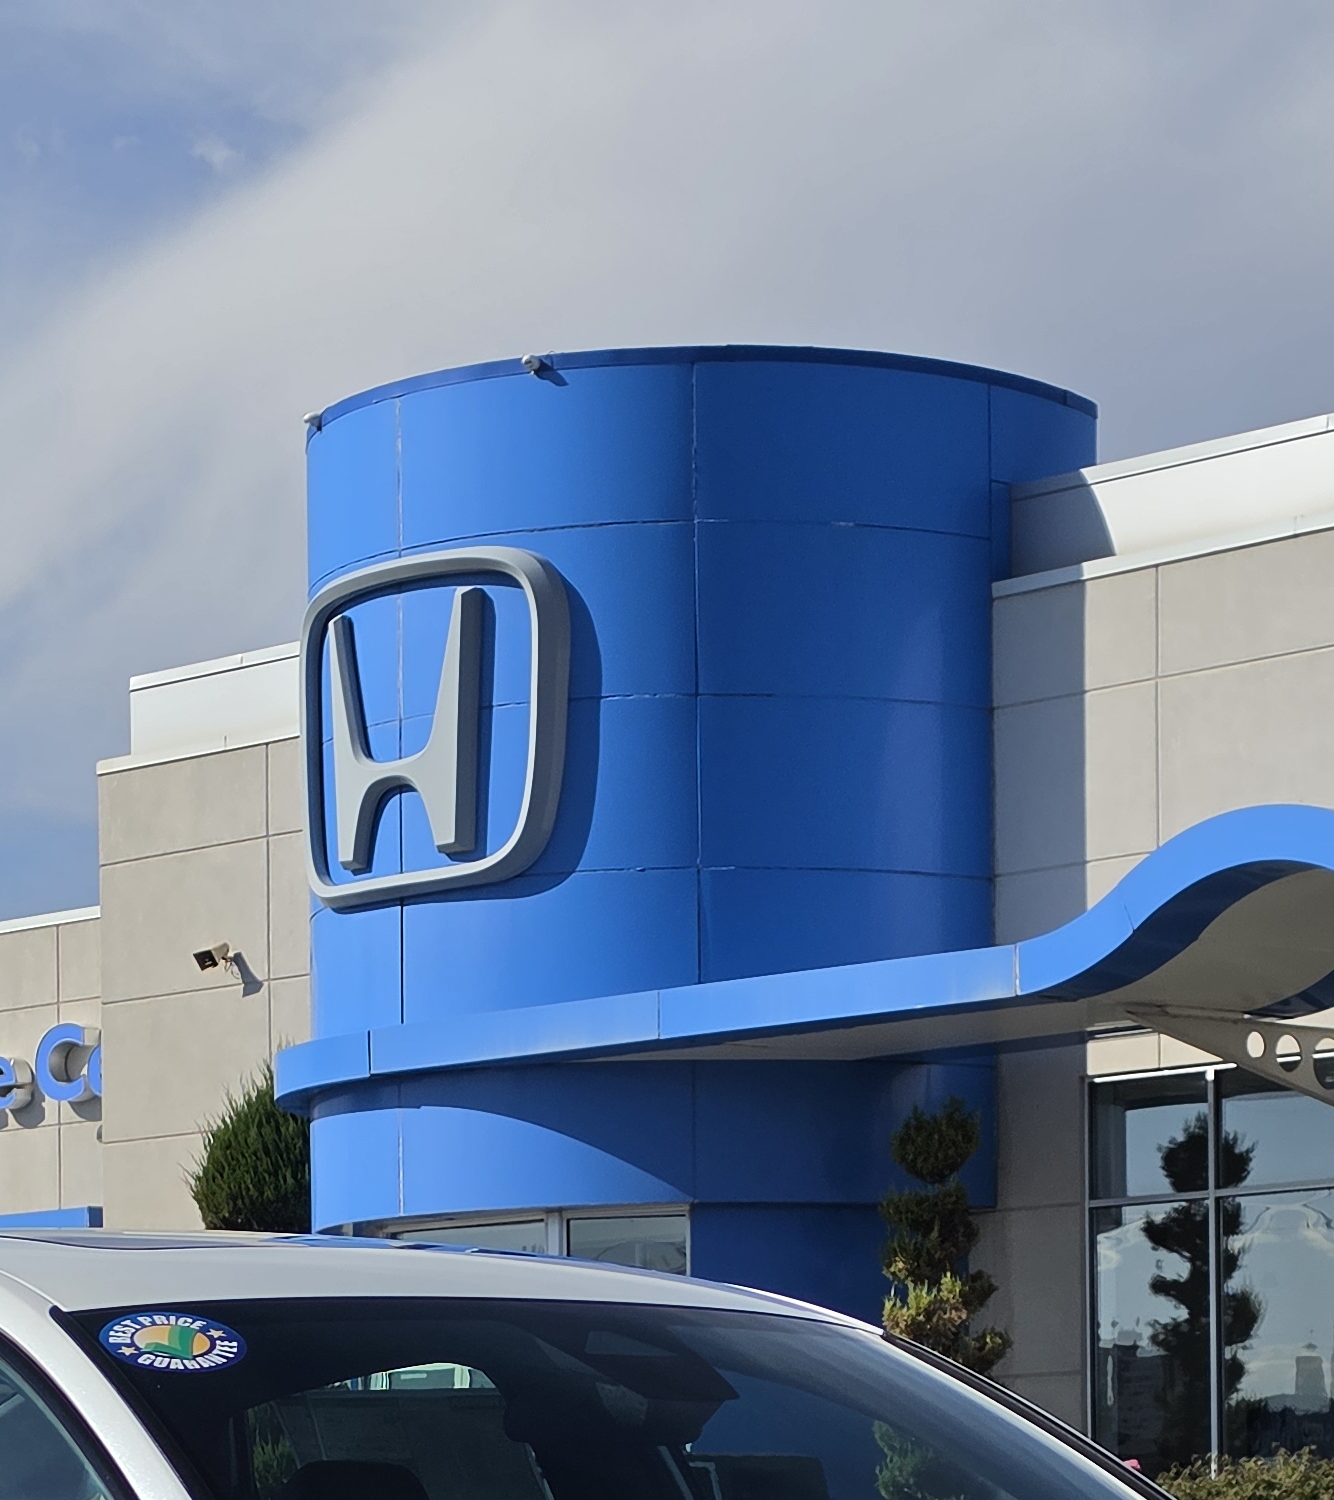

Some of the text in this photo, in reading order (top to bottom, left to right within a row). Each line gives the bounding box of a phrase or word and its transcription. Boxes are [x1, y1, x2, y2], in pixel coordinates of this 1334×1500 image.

[108, 1315, 207, 1344] BEST PRICE
[137, 1340, 238, 1370] GUARANTEE
